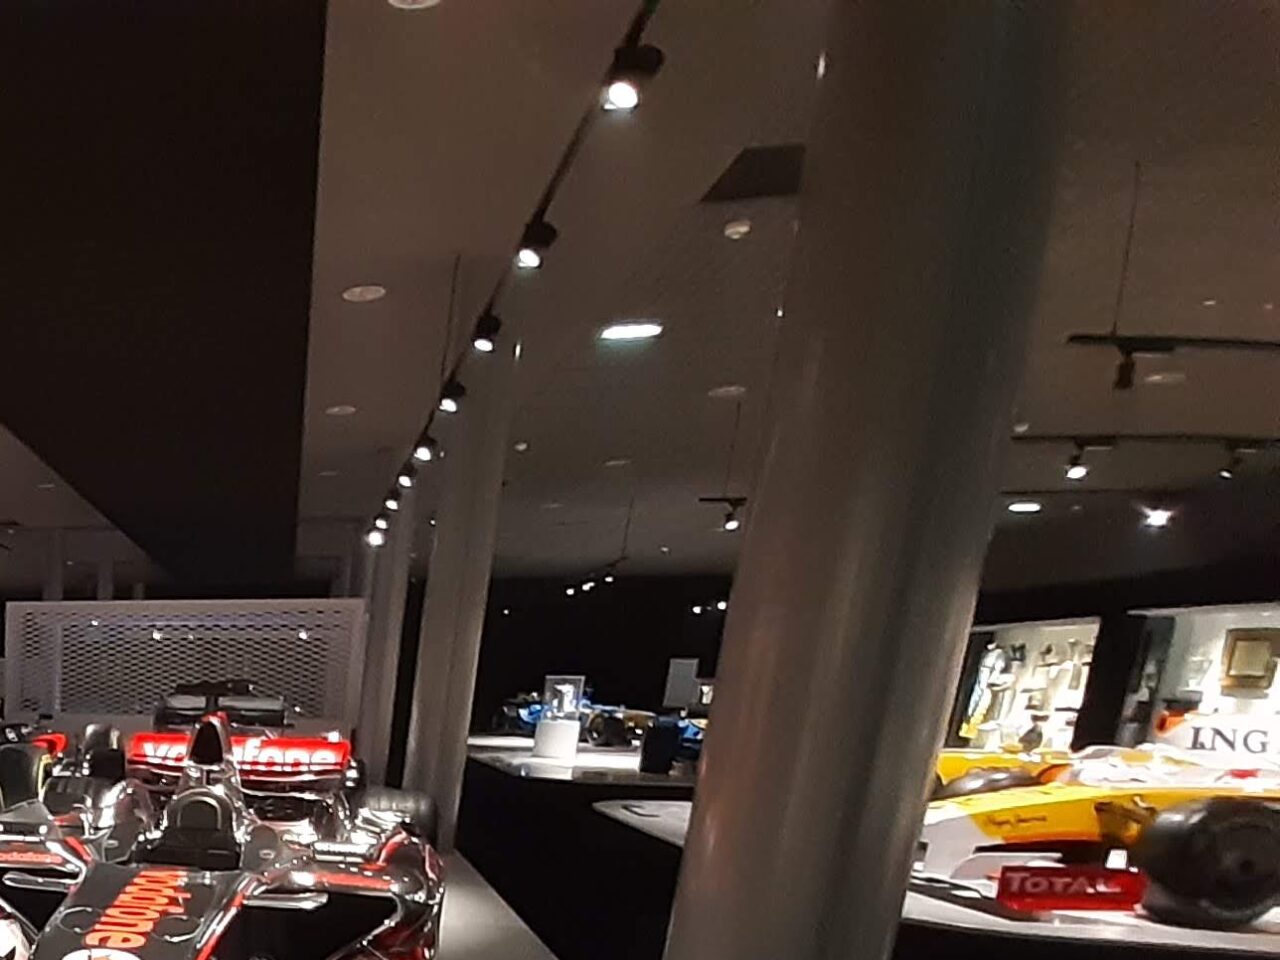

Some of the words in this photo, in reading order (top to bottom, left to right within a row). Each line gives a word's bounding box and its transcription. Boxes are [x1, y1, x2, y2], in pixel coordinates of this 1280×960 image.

[1186, 726, 1269, 753] ING
[1006, 872, 1121, 893] TOTAL
[85, 871, 191, 948] vodafone
